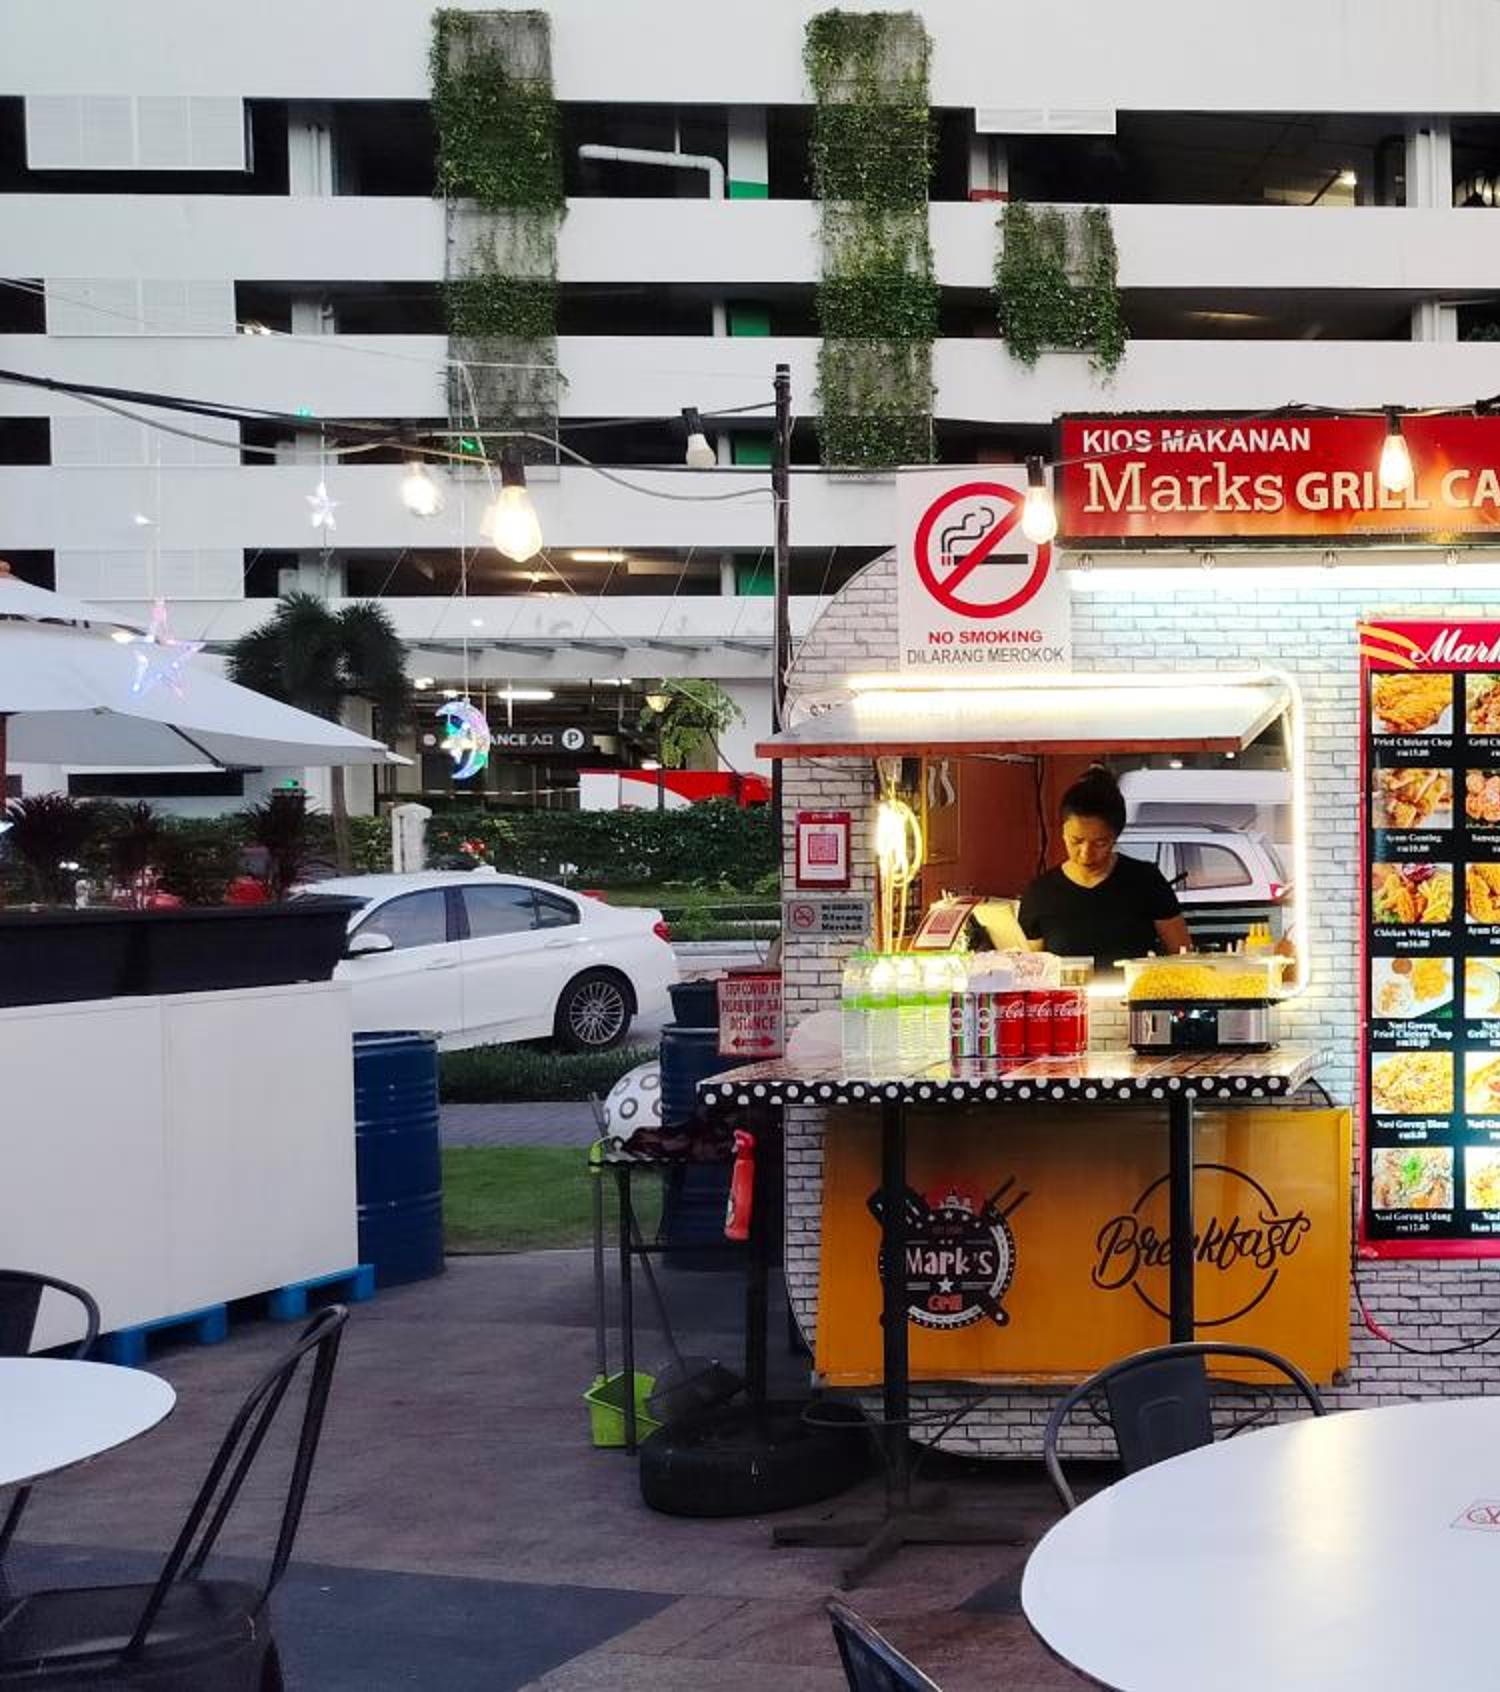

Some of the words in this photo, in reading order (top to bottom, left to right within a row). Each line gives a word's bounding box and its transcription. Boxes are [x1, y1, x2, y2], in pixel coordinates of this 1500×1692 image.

[1083, 430, 1152, 453] KIOS
[1160, 428, 1311, 452] MAKANAN
[1083, 462, 1284, 513] Marks
[1297, 472, 1430, 510] GRILL
[928, 632, 954, 644] NO
[959, 631, 1043, 643] SMOKING
[907, 649, 984, 664] DILARANG
[988, 648, 1065, 662] MEROKOK
[1374, 739, 1394, 747] Fried
[1396, 739, 1430, 747] Chicken
[1431, 739, 1452, 747] Chop
[1469, 739, 1488, 747] Grill
[1374, 929, 1406, 938] Chicken
[1409, 929, 1430, 938] Wing
[1432, 929, 1451, 938] Plate
[1374, 1031, 1394, 1040] Fried
[1092, 1210, 1310, 1290] Brekfast
[905, 1247, 993, 1275] Mark's
